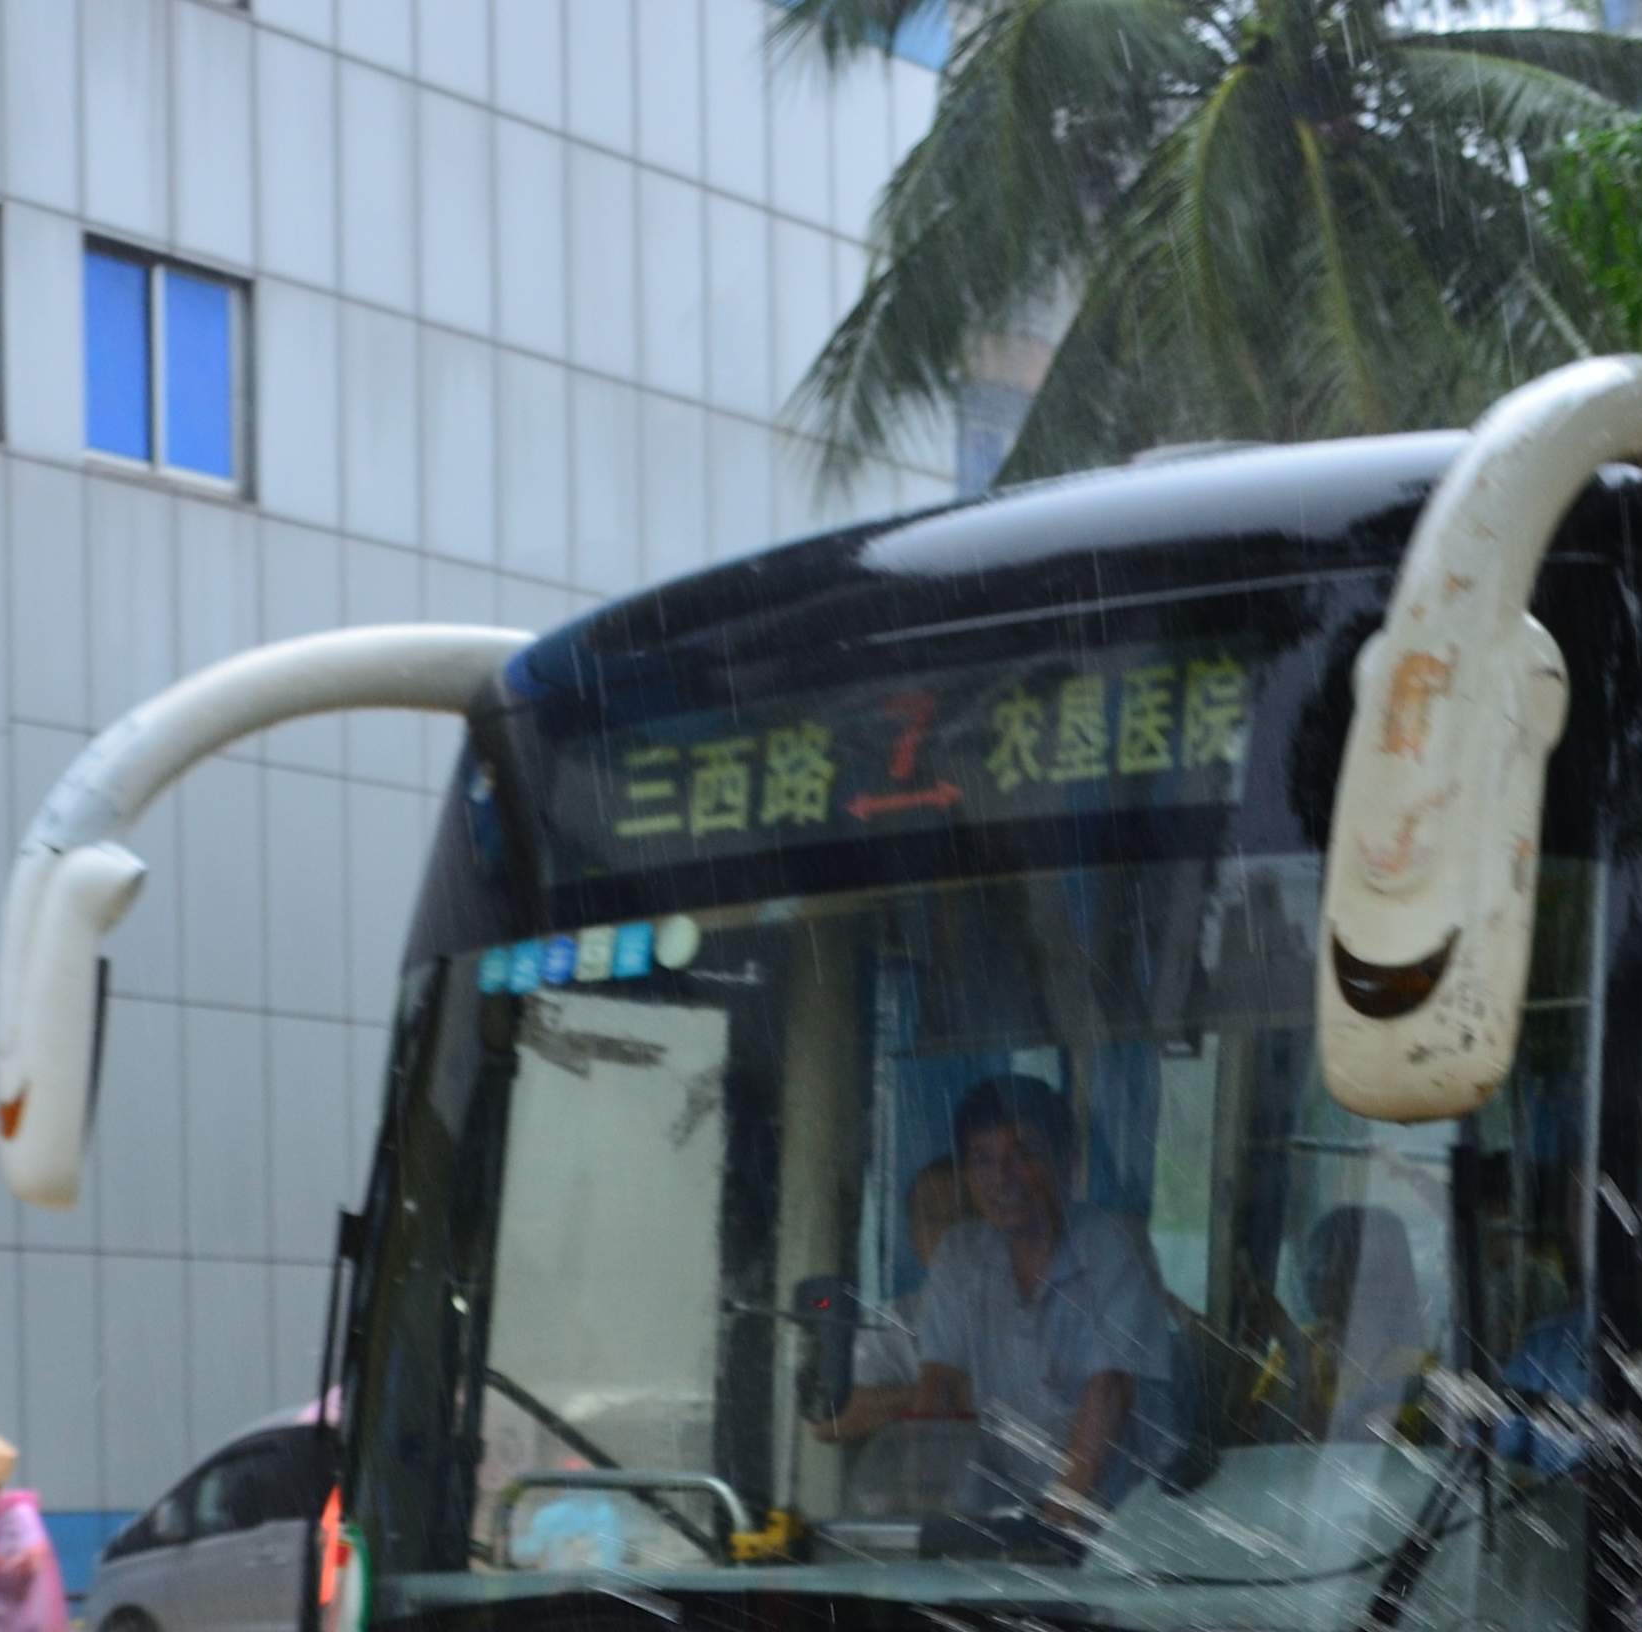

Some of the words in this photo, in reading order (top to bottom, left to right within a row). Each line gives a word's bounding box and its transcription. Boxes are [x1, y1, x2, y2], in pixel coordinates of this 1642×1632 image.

[615, 720, 839, 838] 三西路
[881, 692, 938, 780] 7
[985, 654, 1250, 793] 农垦医院
